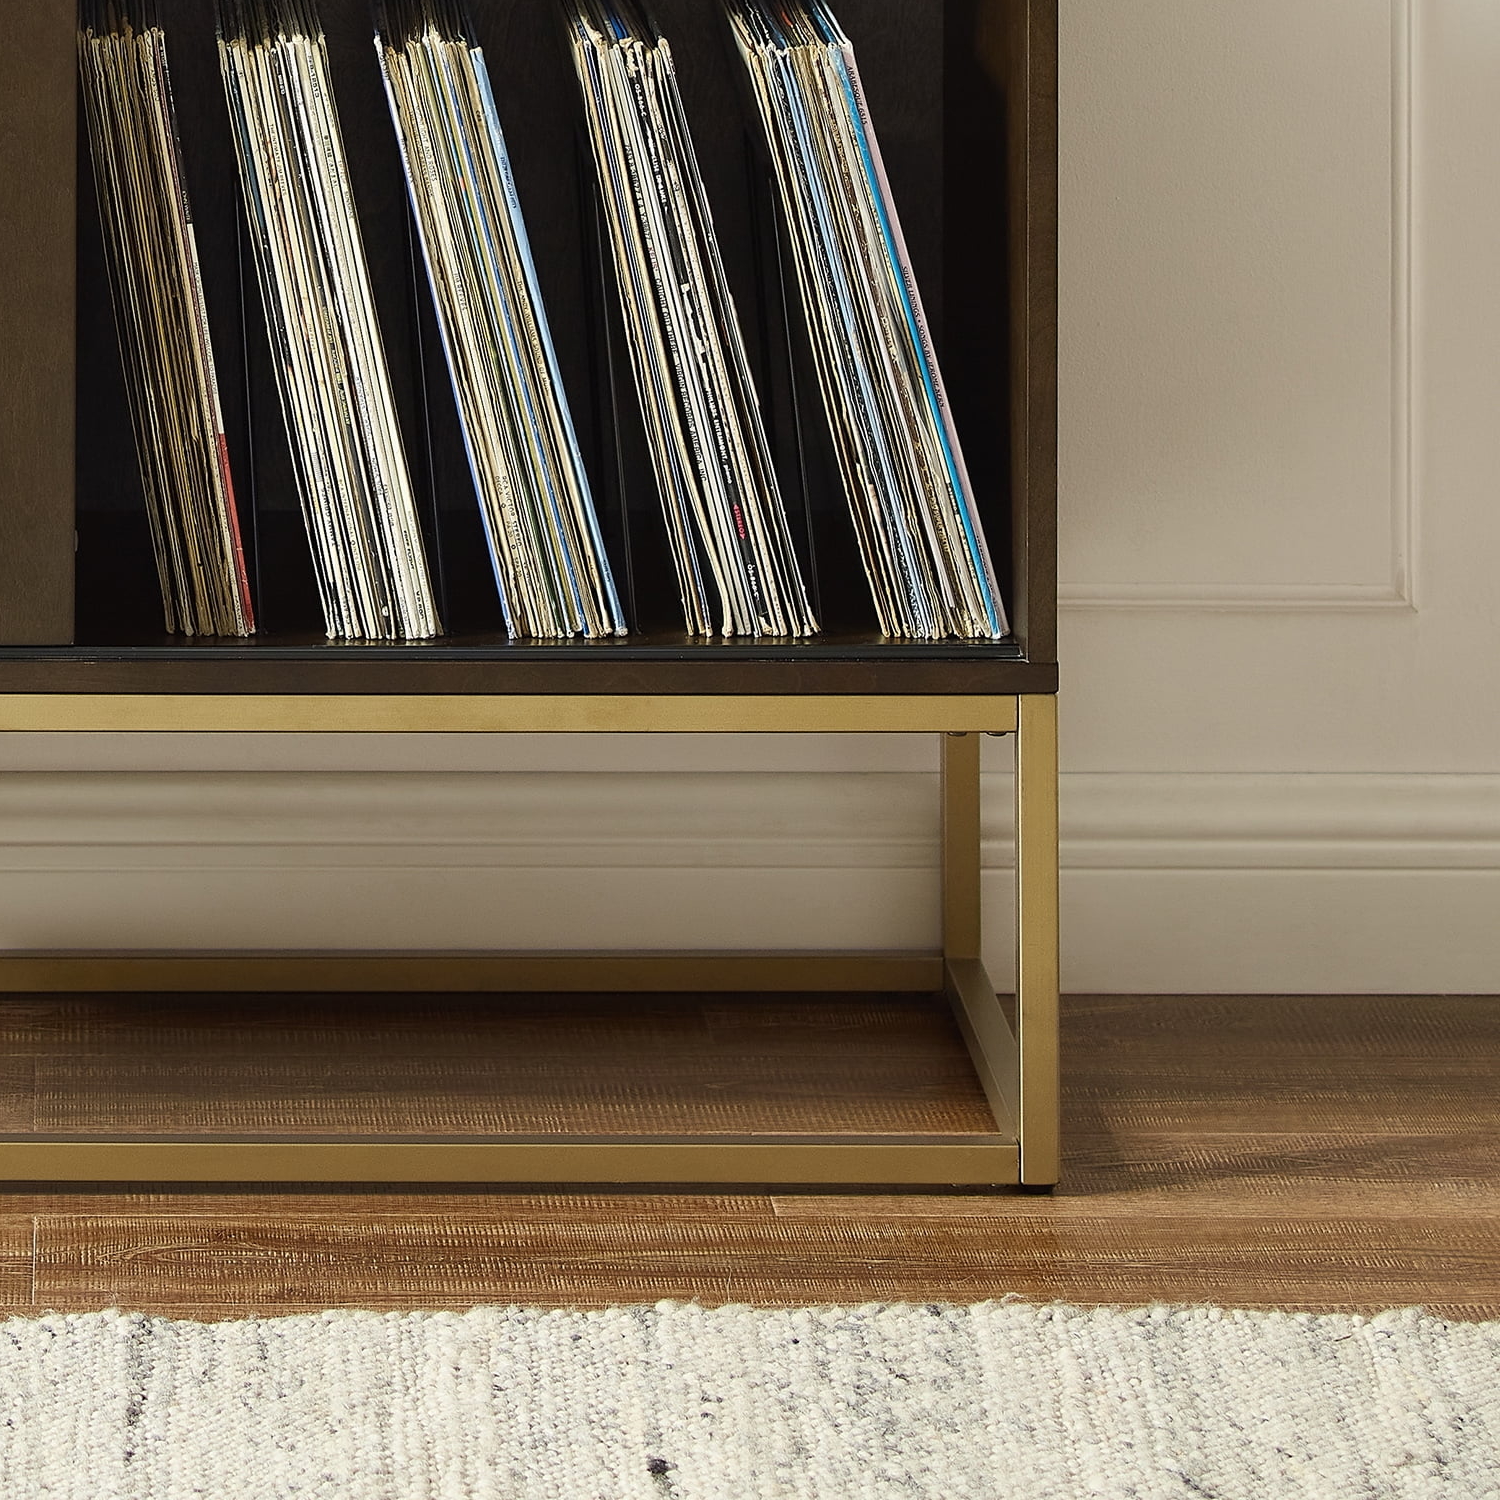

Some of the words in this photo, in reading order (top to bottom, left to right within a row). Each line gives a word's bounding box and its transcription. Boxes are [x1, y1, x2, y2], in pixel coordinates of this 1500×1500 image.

[847, 65, 862, 106] ARABESQUE
[902, 265, 912, 289] SILVER
[908, 289, 919, 317] LININGS
[918, 324, 928, 348] SONGS
